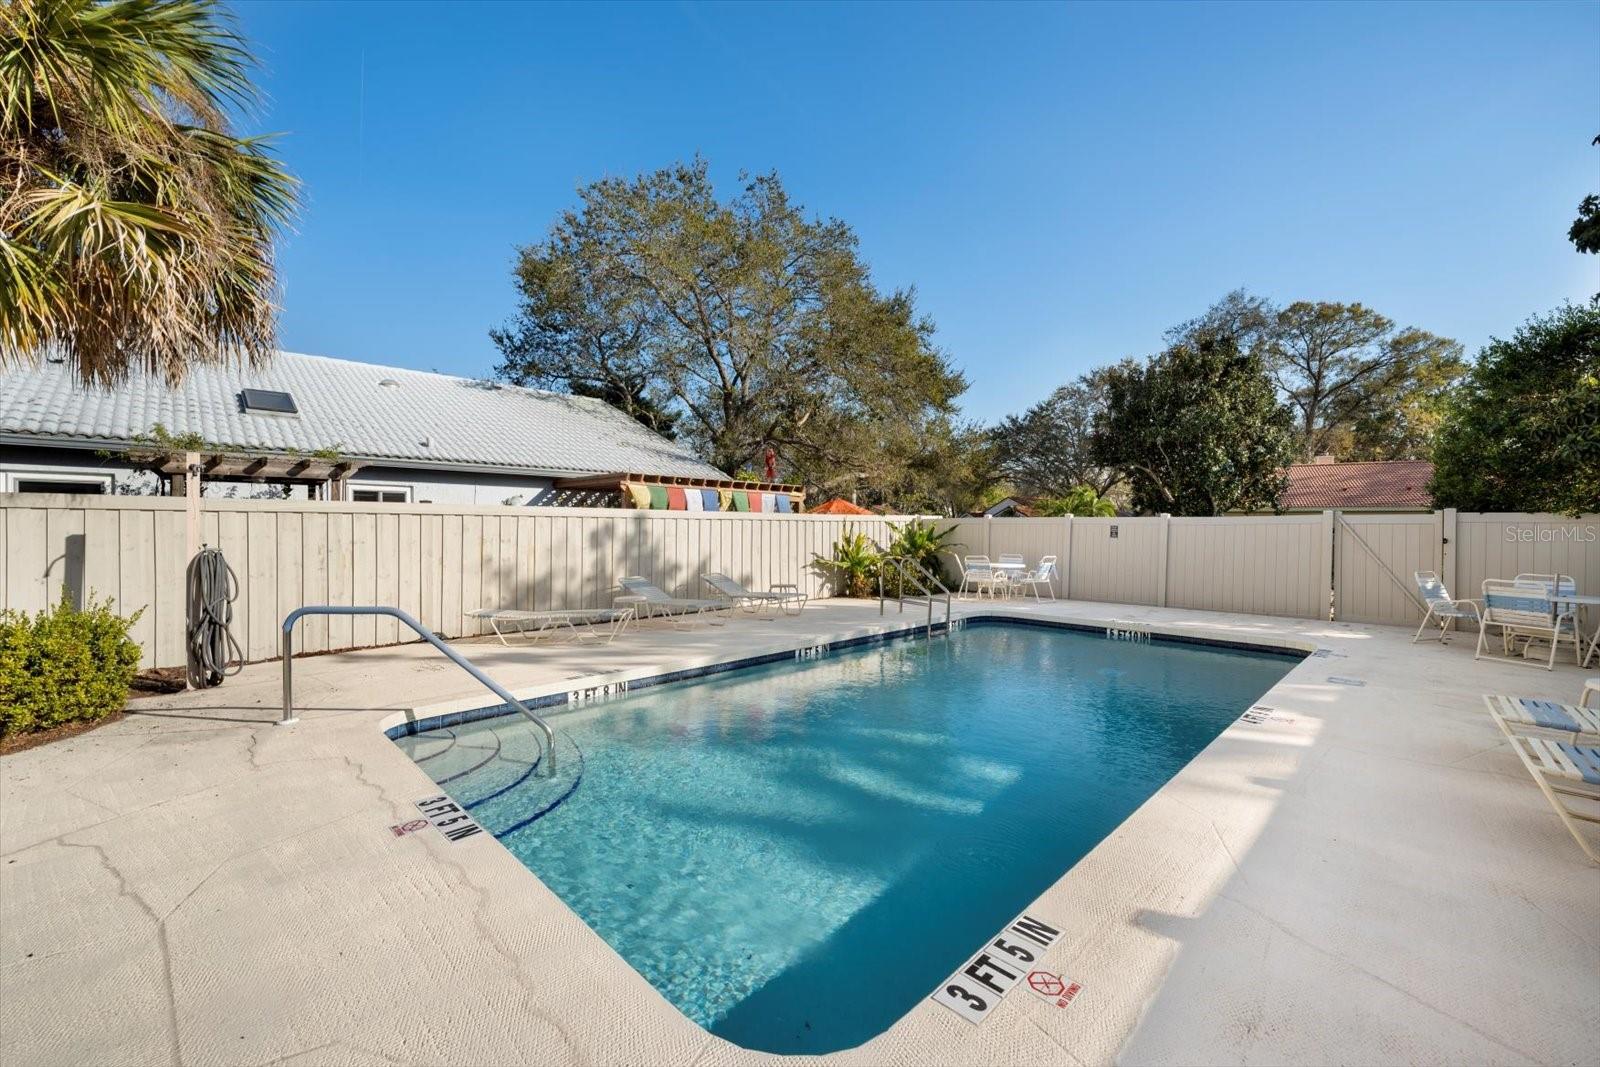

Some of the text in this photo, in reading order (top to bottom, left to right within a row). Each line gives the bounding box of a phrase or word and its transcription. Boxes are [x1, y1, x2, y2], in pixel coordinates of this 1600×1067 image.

[584, 687, 598, 700] FT
[615, 682, 626, 694] IN
[418, 796, 483, 842] 3 FT 5 IN
[946, 915, 1060, 1012] 3 FT 5 IN
